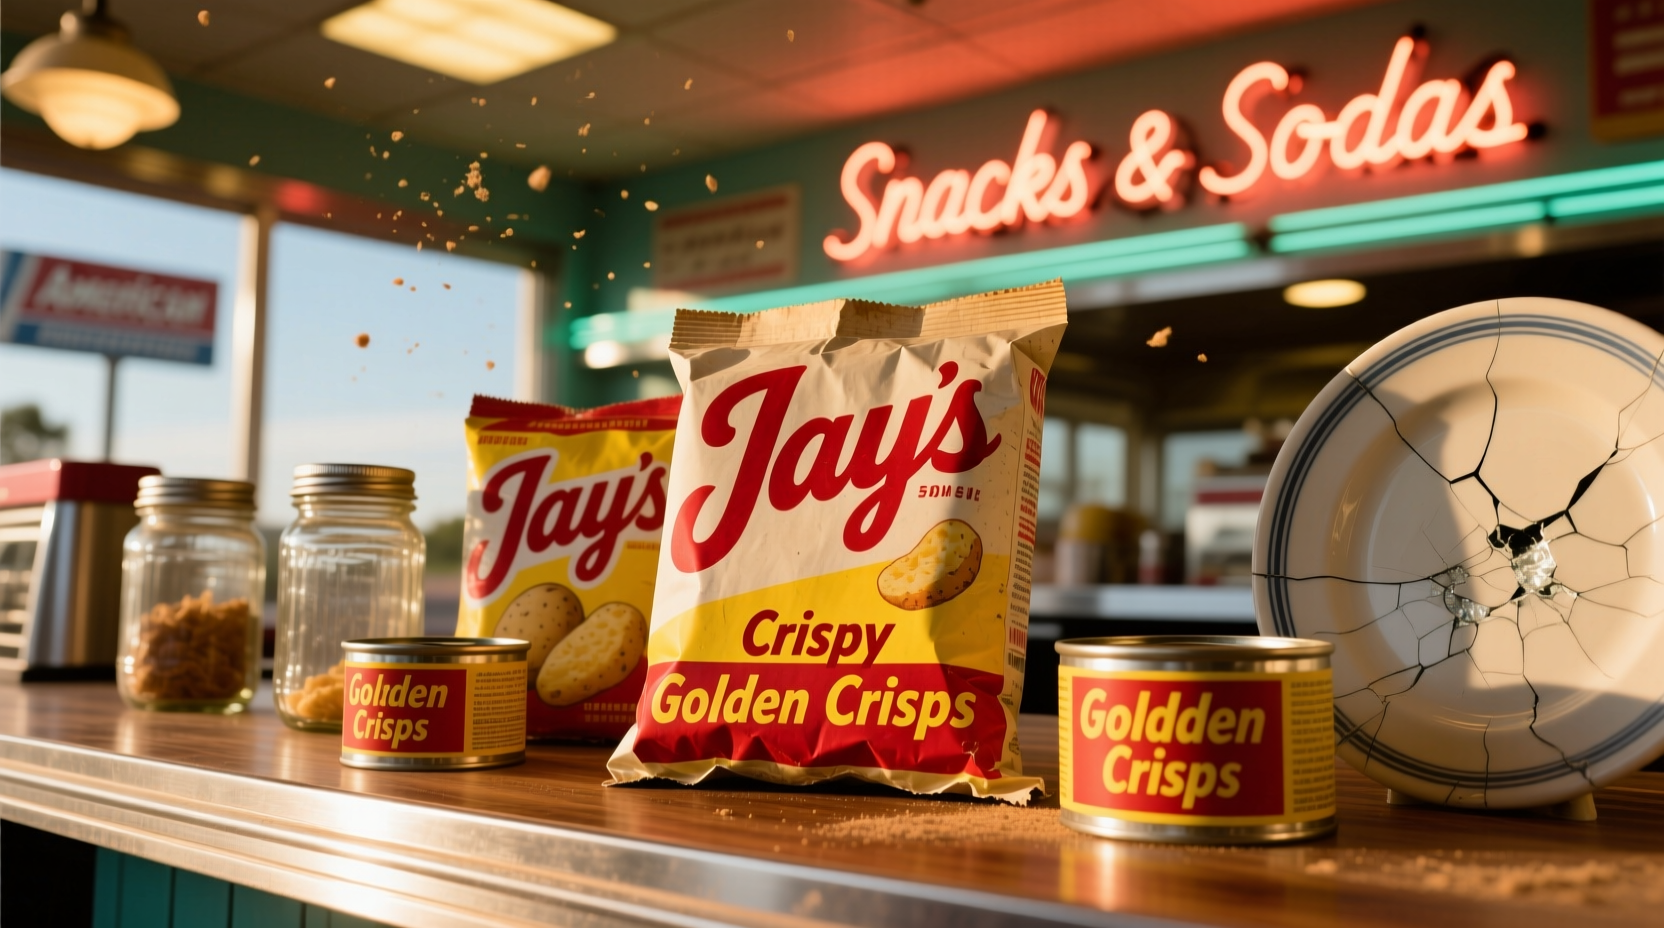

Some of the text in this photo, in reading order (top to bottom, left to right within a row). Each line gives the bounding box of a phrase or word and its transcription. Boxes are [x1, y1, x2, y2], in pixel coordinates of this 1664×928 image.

[823, 36, 1529, 262] Snacks & Sodas
[671, 360, 1002, 574] Jay's
[466, 451, 667, 600] Jay's
[742, 609, 896, 669] Crispy
[352, 708, 429, 750] Crisps
[650, 672, 977, 741] Golden Crisps
[1080, 687, 1266, 745] Goldden
[1102, 744, 1242, 810] Crisps
